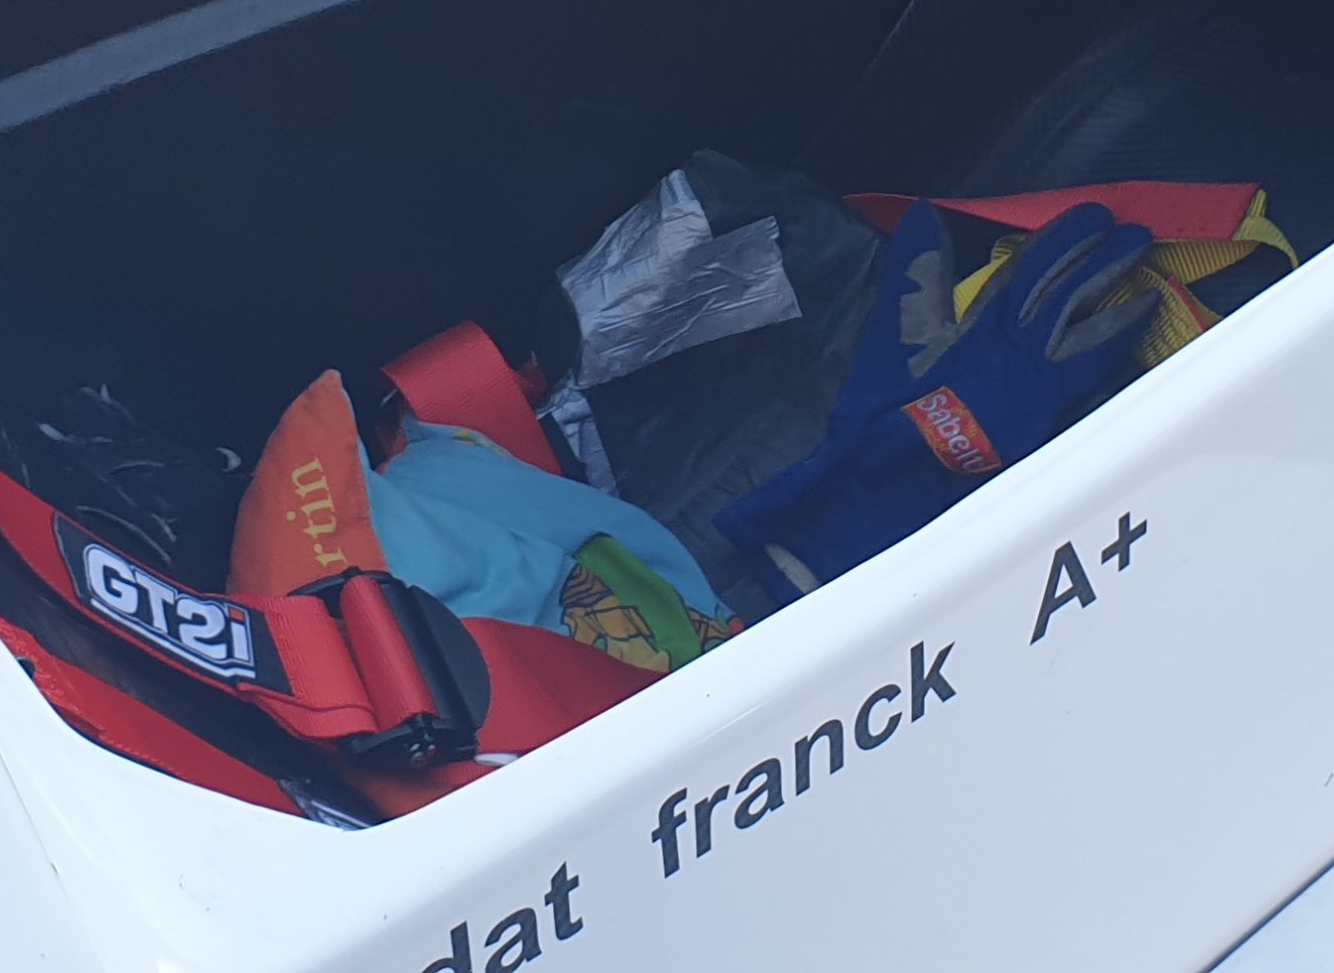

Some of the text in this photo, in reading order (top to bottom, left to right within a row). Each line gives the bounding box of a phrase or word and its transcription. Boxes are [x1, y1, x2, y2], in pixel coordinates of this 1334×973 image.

[286, 457, 346, 568] rtin
[81, 543, 253, 665] GT2i
[651, 639, 957, 879] franck
[1029, 511, 1148, 645] A+
